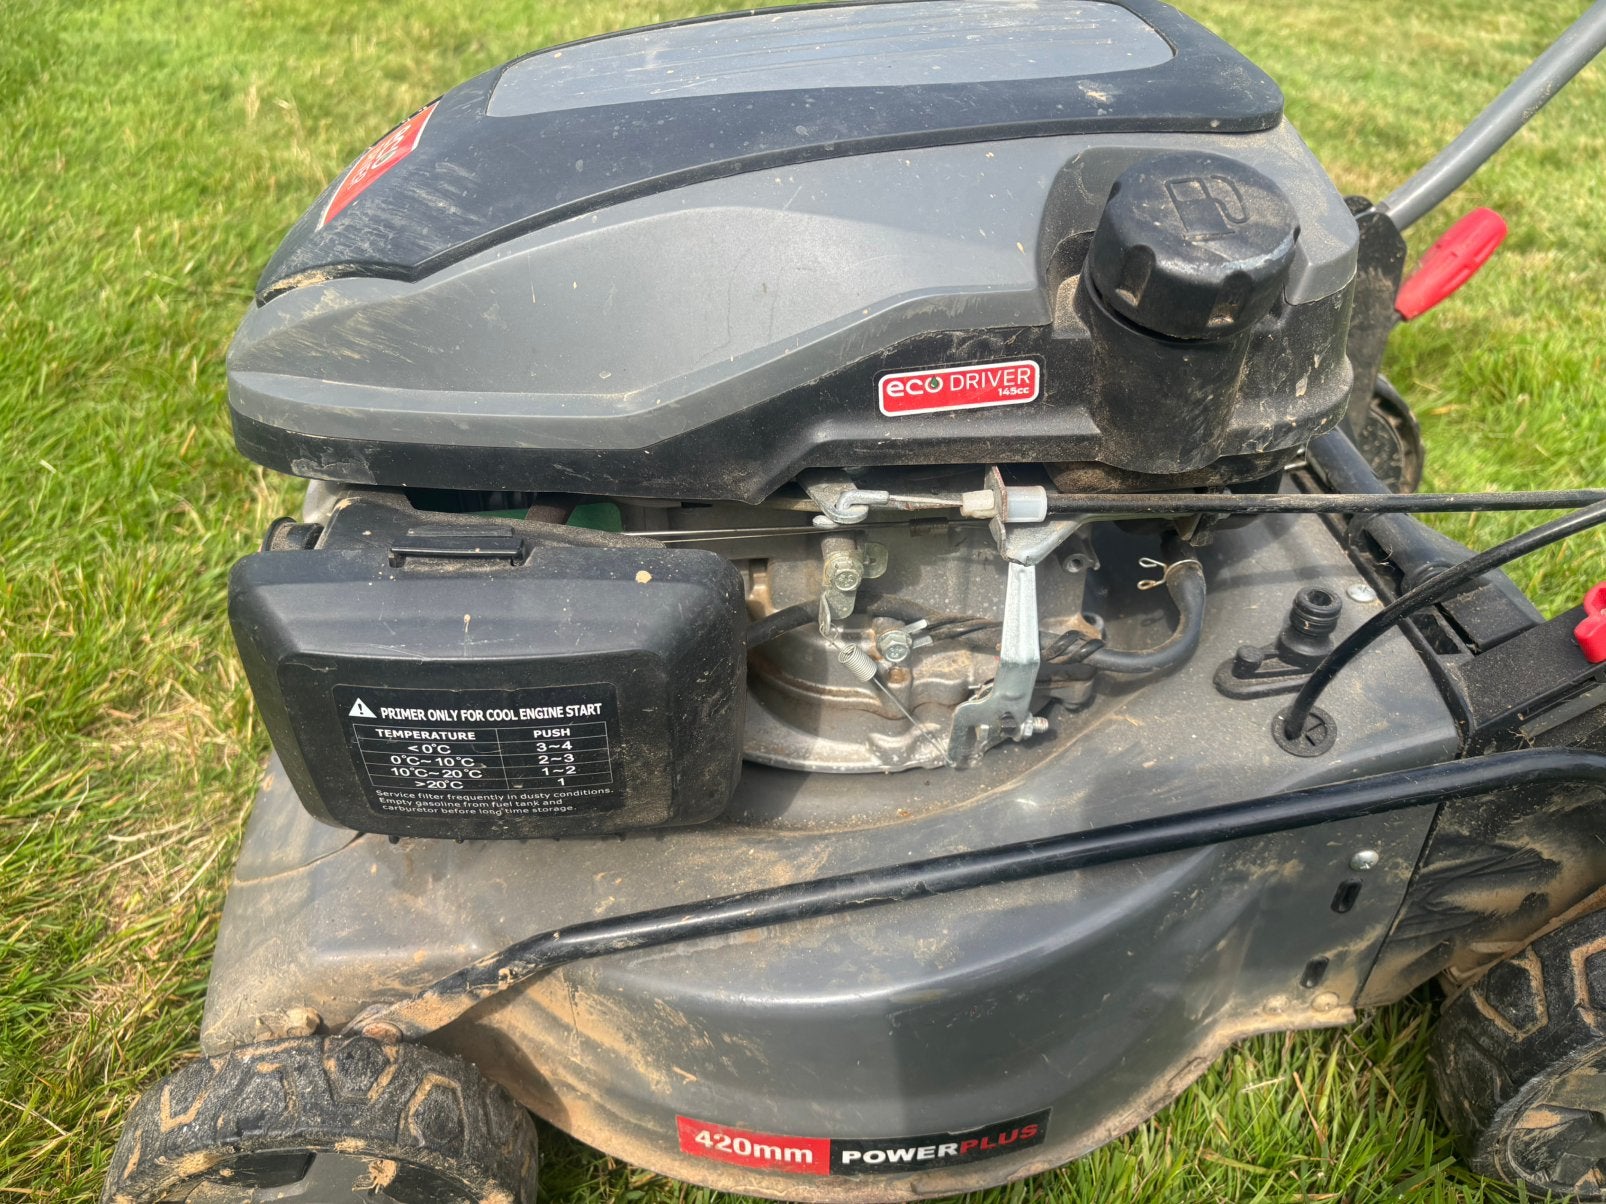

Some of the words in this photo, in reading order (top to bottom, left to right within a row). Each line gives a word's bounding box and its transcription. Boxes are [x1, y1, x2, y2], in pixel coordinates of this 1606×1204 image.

[886, 375, 943, 397] eco
[950, 367, 1031, 391] DRIVER
[998, 386, 1030, 396] 145cc
[380, 707, 427, 721] PRIMER
[427, 709, 458, 721] ONLY
[460, 709, 486, 721] FOR
[486, 709, 519, 721] COOL
[519, 706, 564, 720] ENGINE
[565, 703, 602, 717] START
[374, 728, 476, 740] TEMPERATURE
[533, 728, 571, 738] PUSH
[557, 777, 565, 786] 1
[375, 789, 416, 799] Service
[417, 792, 444, 800] filter
[447, 793, 504, 801] frequently
[520, 792, 551, 800] dusty
[553, 788, 614, 798] conditions.
[379, 797, 413, 806] Empty
[415, 799, 461, 808] gasoline
[515, 800, 540, 808] tank
[382, 804, 438, 813] carburetor
[479, 808, 502, 816] long
[532, 805, 577, 813] storage.
[694, 1129, 814, 1164] 420mm
[841, 1123, 1039, 1165] POWERPLUS
